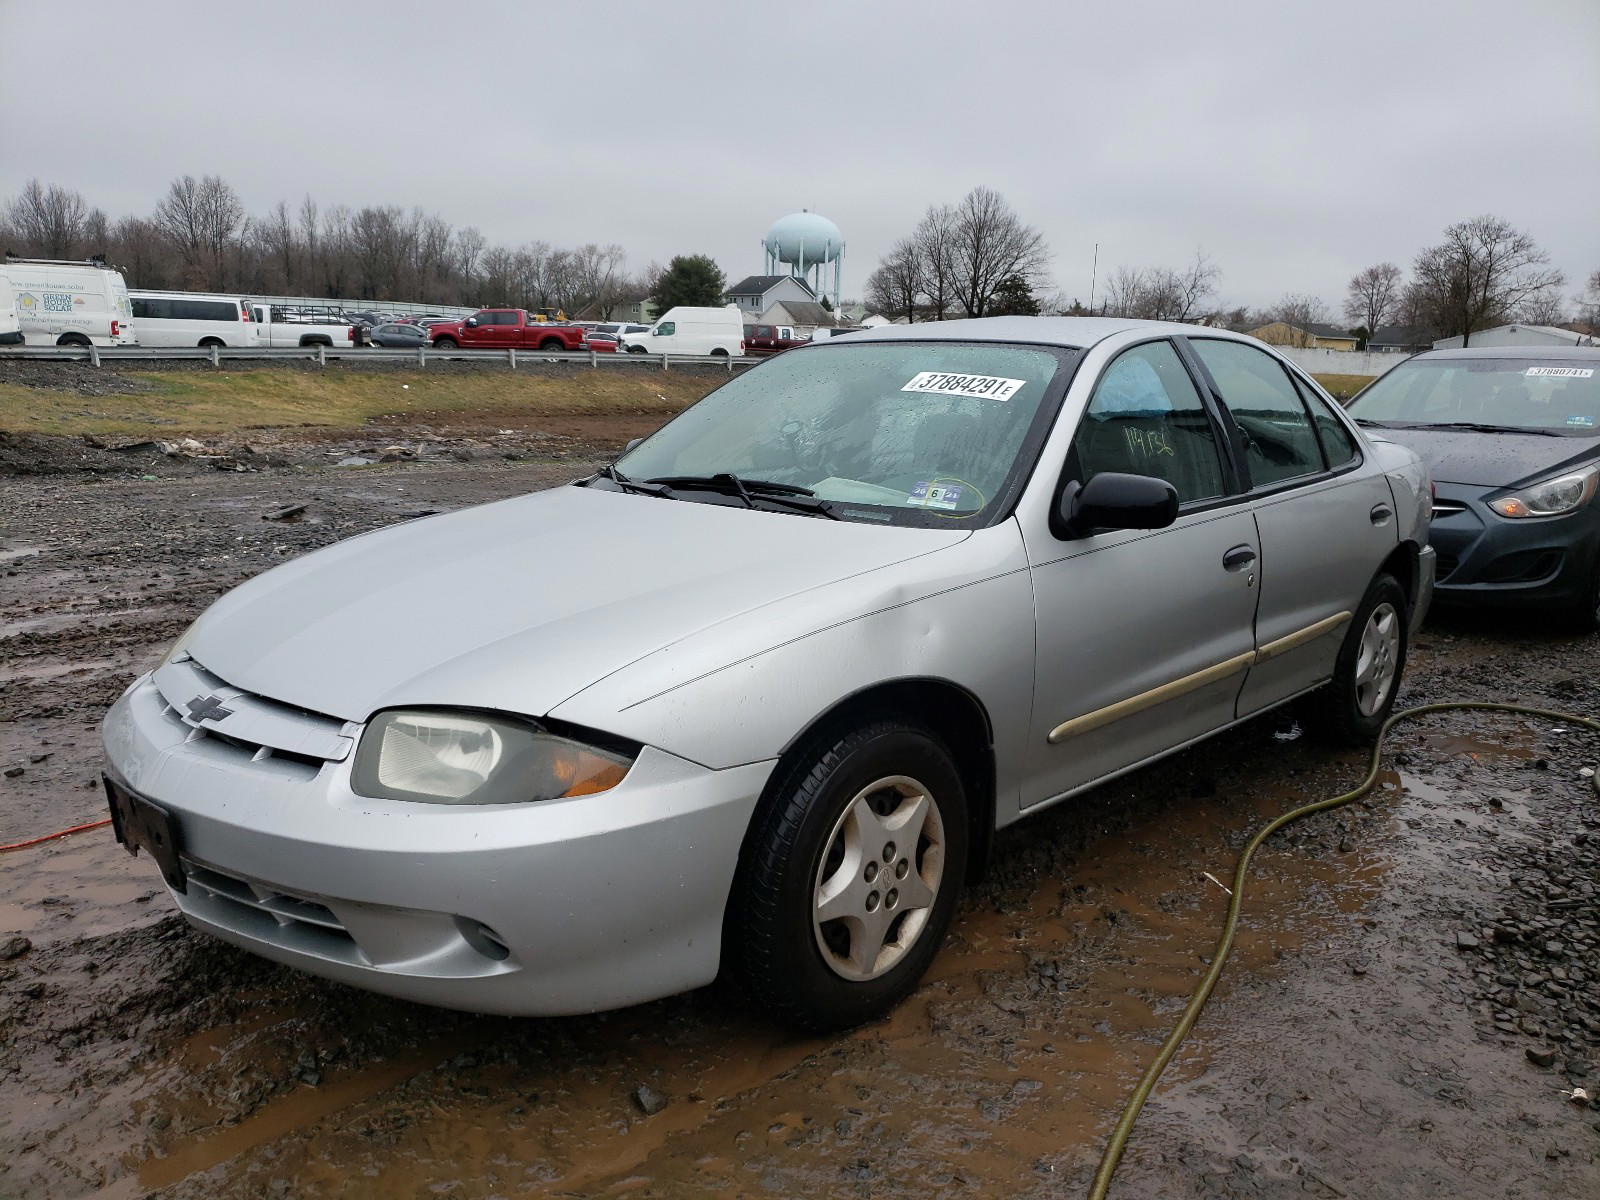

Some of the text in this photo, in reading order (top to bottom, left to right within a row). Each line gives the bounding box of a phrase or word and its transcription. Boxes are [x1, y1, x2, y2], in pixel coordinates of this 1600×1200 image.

[919, 374, 1007, 395] 37884291
[1000, 386, 1013, 396] E
[931, 489, 939, 498] 6
